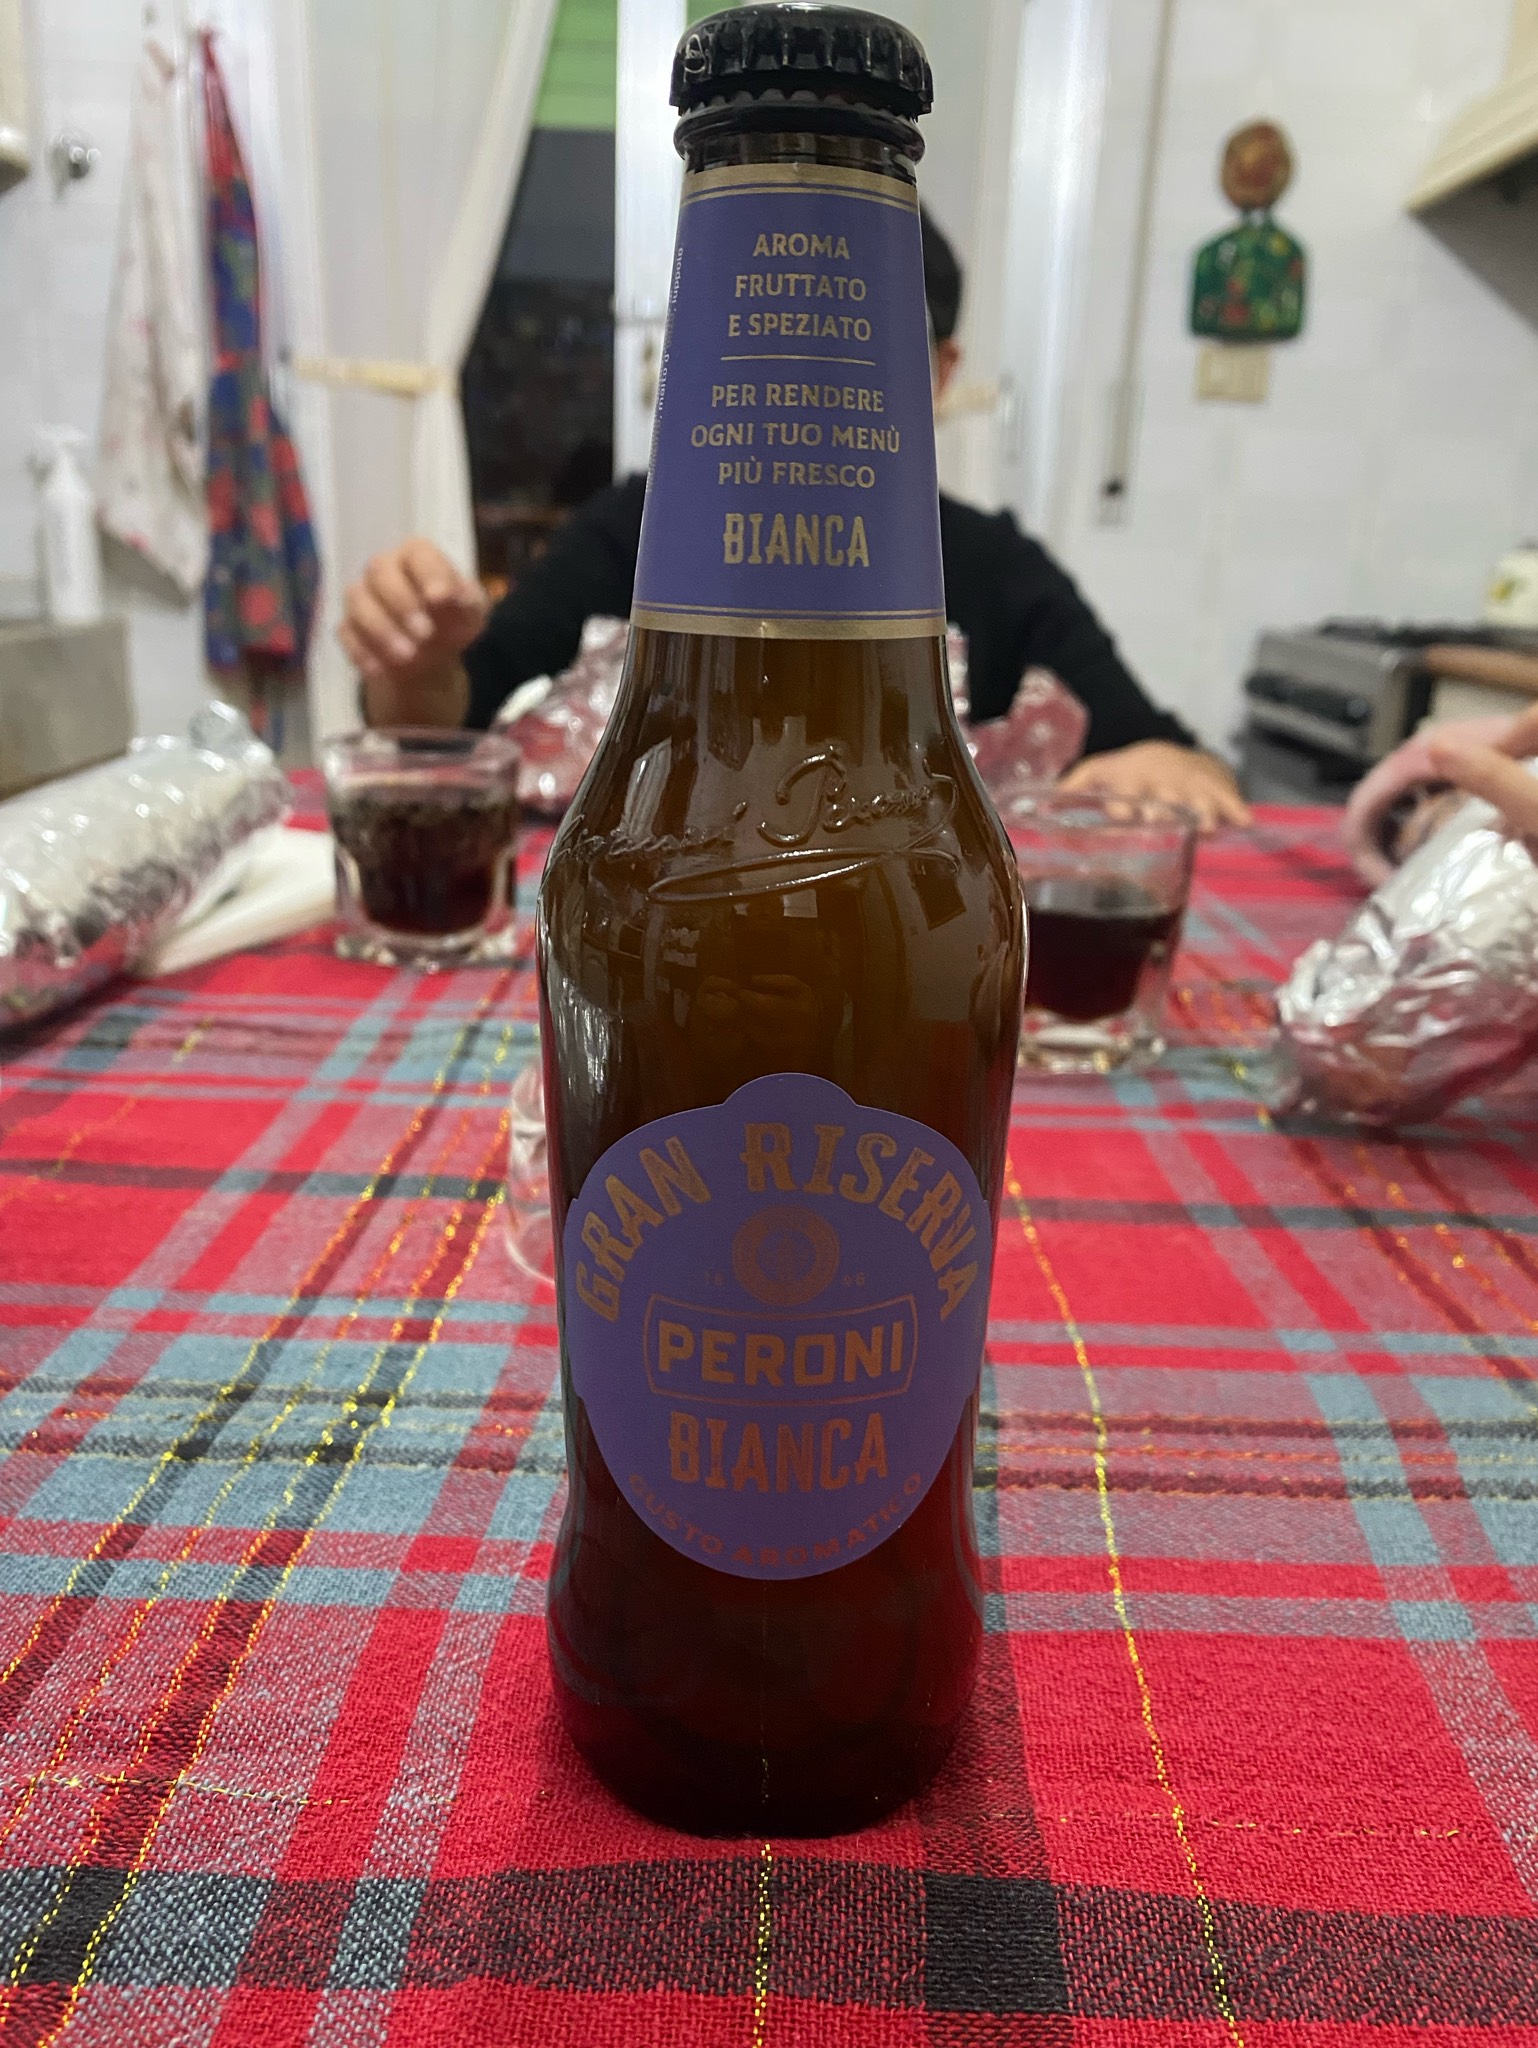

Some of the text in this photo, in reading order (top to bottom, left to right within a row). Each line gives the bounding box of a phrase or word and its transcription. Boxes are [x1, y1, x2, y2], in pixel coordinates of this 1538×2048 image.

[753, 233, 851, 260] AROMA
[735, 273, 867, 302] FRUTTATO
[729, 313, 872, 341] E SPEZIATO
[711, 383, 885, 413] PER RENDERE
[690, 423, 901, 453] OGNI TUO MENÙ
[718, 455, 876, 488] PIÙ FRESCO
[722, 512, 870, 568] BIANCA
[576, 1122, 979, 1323] GRAN RISERVA
[658, 1320, 904, 1387] PERONI
[668, 1411, 888, 1493] BIANCA
[628, 1472, 922, 1567] GUSTO AROMATICO
